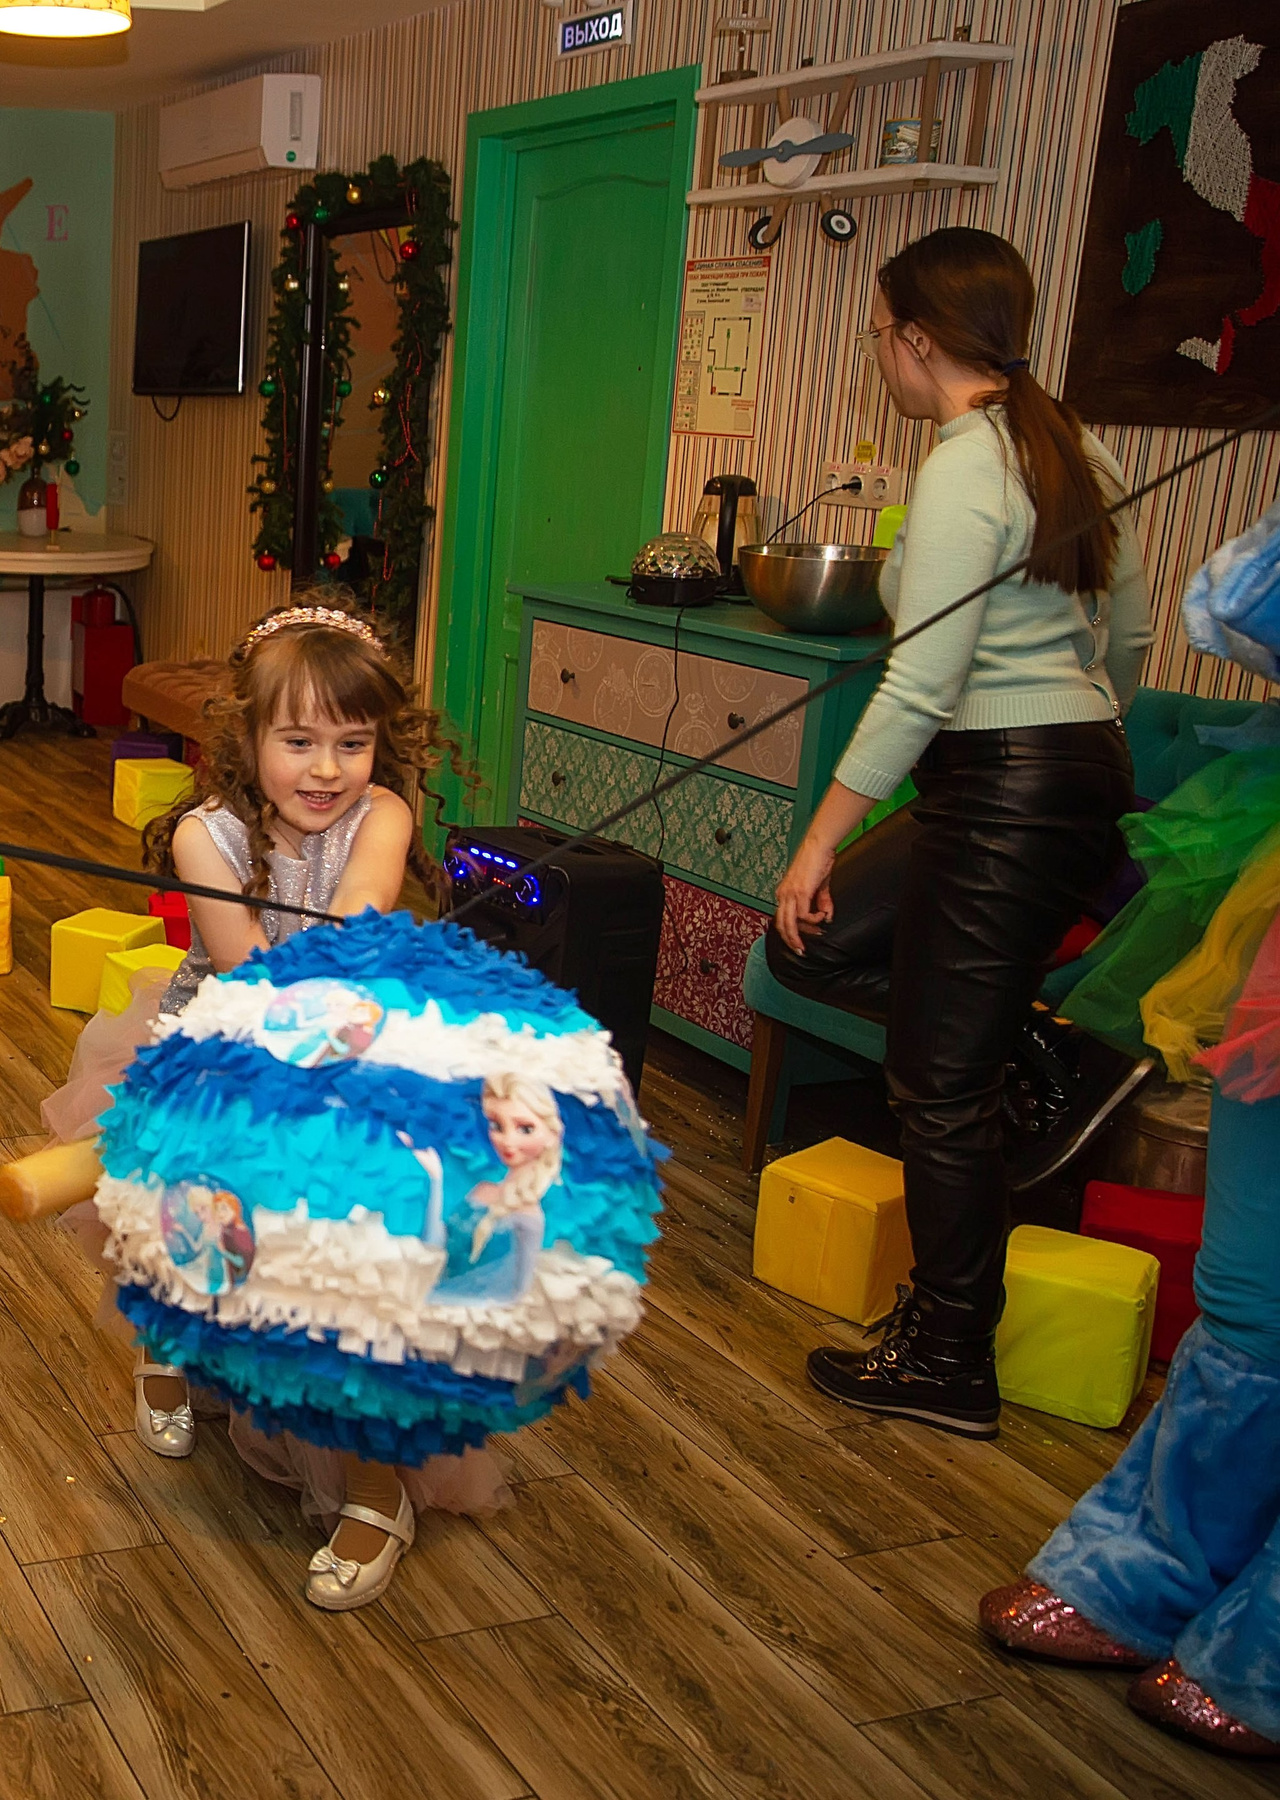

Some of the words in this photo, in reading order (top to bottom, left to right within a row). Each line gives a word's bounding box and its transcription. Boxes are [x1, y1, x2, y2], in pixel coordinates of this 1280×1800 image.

[564, 12, 623, 49] ВЫХОД
[728, 20, 760, 29] MERRY
[45, 205, 70, 241] E
